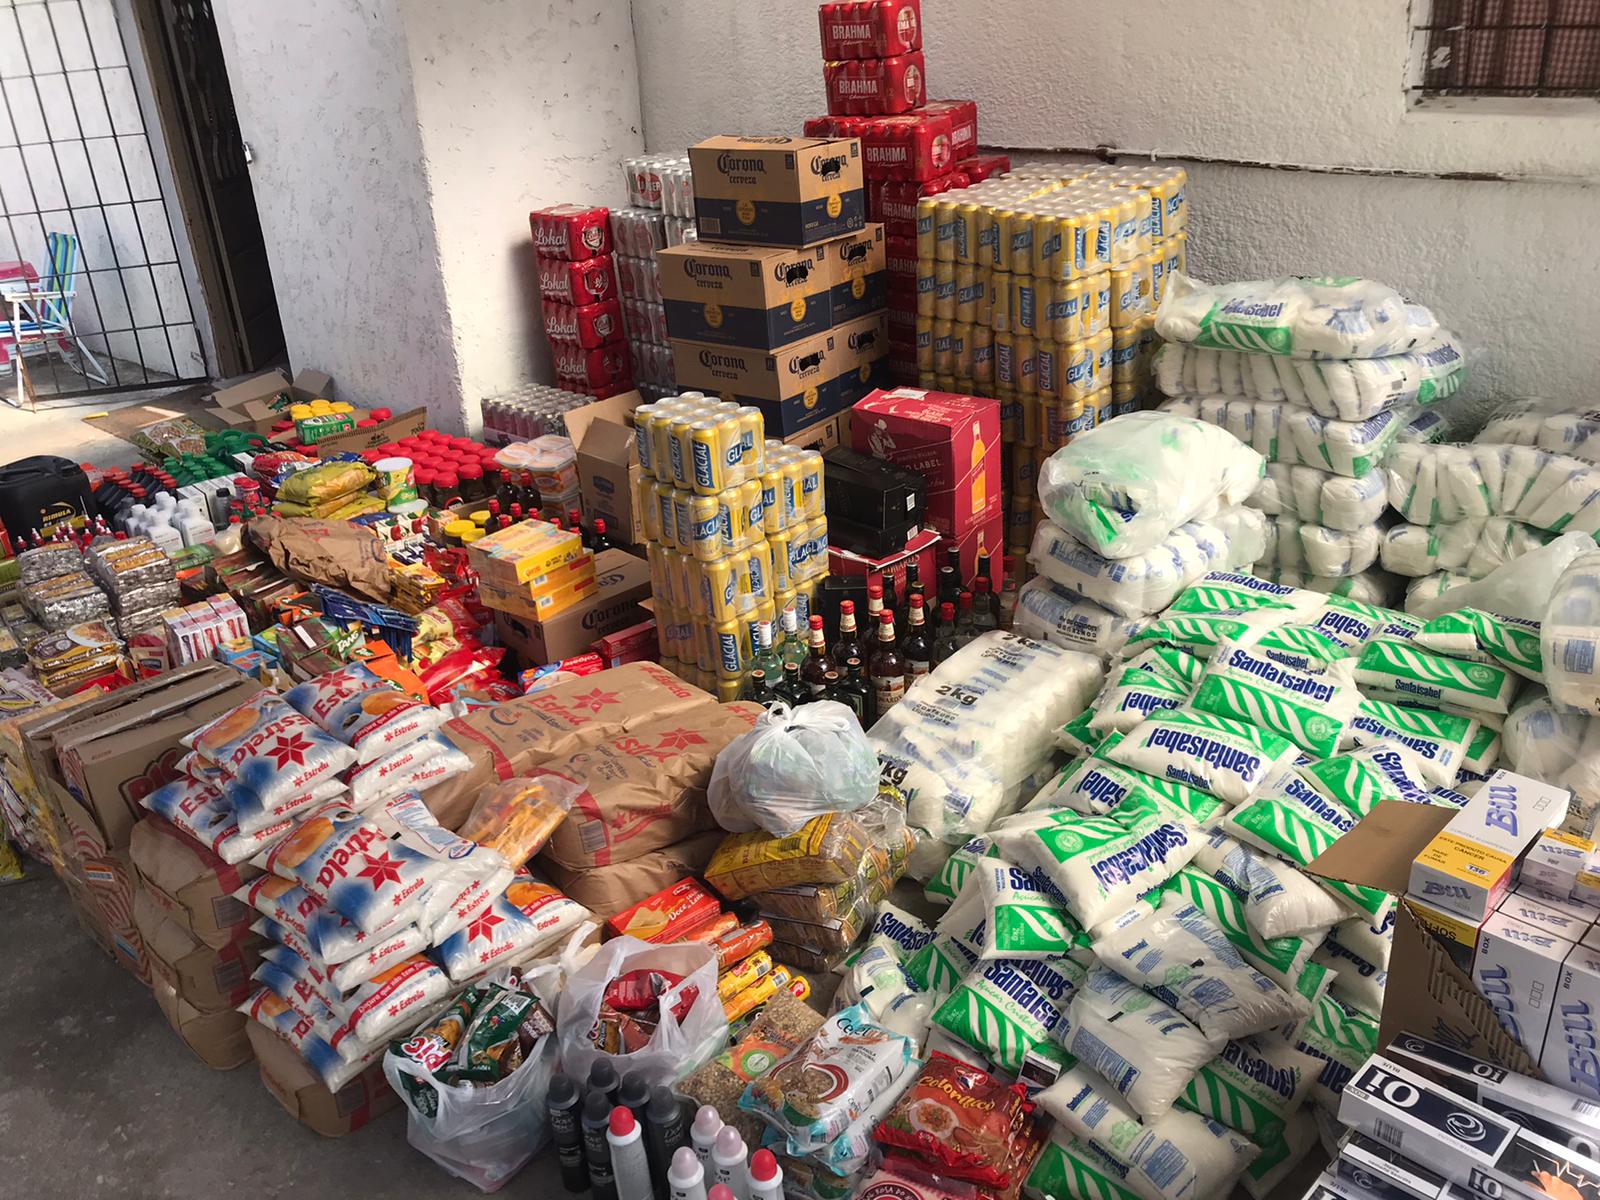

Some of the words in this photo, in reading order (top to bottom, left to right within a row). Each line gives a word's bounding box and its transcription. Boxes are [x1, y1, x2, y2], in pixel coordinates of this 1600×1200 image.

[832, 24, 872, 40] BRAHMA
[838, 79, 878, 94] BRAHMA
[717, 152, 768, 176] Corona
[866, 147, 907, 162] BRAHMA
[535, 227, 568, 246] Lokal
[683, 257, 733, 280] Corona
[540, 272, 569, 290] Lokal
[546, 317, 577, 334] Lokal
[557, 357, 587, 374] Lokal
[699, 350, 748, 373] Corona
[1000, 345, 1011, 382] GLACIAL
[1039, 351, 1051, 391] GLACIAL
[695, 443, 711, 487] GLACIAL
[913, 459, 942, 471] LABEL
[337, 631, 360, 651] TANG
[562, 653, 599, 667] Colgate
[722, 634, 738, 672] GLACIAL
[935, 685, 978, 706] 2kg
[393, 721, 418, 737] Estrela
[303, 761, 330, 781] Estrela
[388, 753, 413, 772] Estrela
[420, 766, 446, 780] Estrela
[285, 792, 313, 812] Estrela
[1485, 784, 1518, 837] Bill
[400, 878, 426, 900] Estrela
[1423, 880, 1472, 900] Bill
[668, 905, 688, 921] Doce
[536, 915, 560, 931] Estrela
[380, 941, 406, 957] Estrela
[489, 941, 515, 959] Estrela
[1482, 936, 1490, 955] BOX
[1563, 971, 1574, 990] BOX
[400, 990, 425, 1010] Estrela
